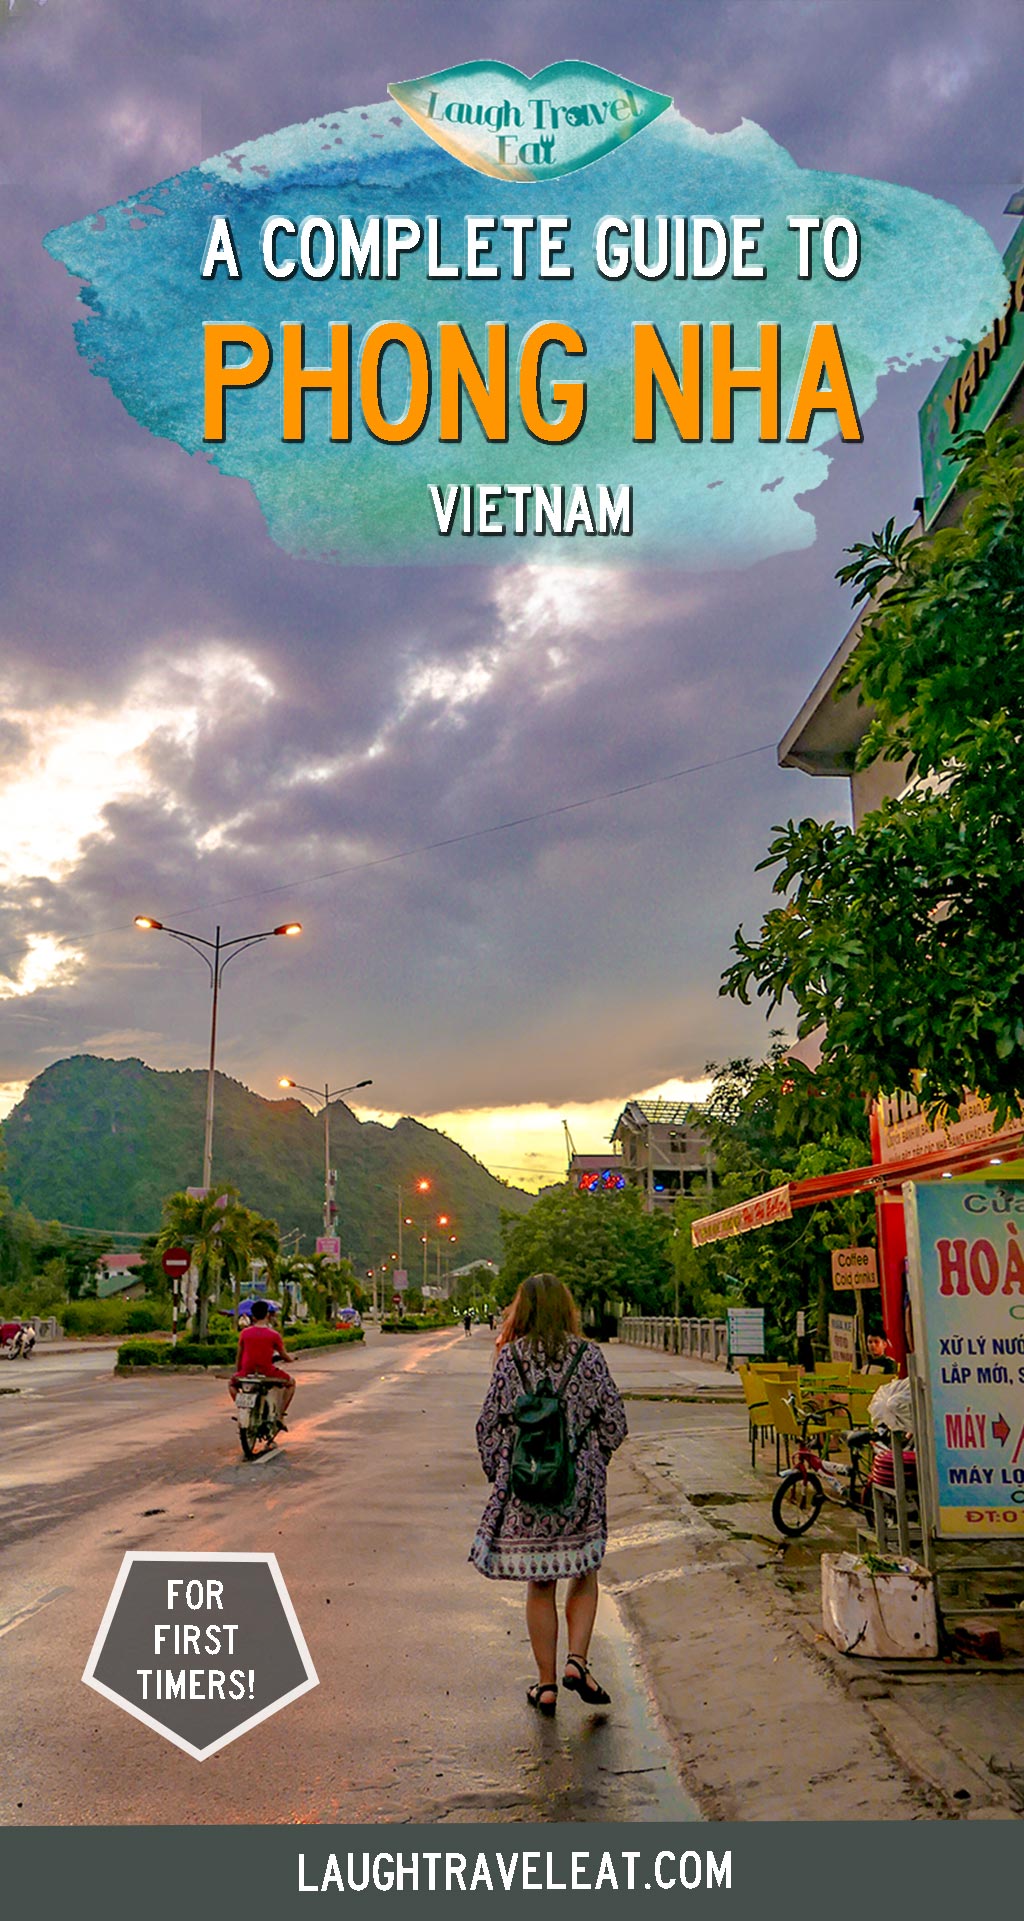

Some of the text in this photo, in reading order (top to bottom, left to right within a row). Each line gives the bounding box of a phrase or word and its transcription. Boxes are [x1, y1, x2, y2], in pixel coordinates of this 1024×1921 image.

[838, 1253, 869, 1268] Coffee
[834, 1271, 876, 1287] Cold drinks
[967, 1335, 986, 1355] LÝ
[945, 1406, 986, 1449] MÁY
[949, 1465, 994, 1484] MÁY
